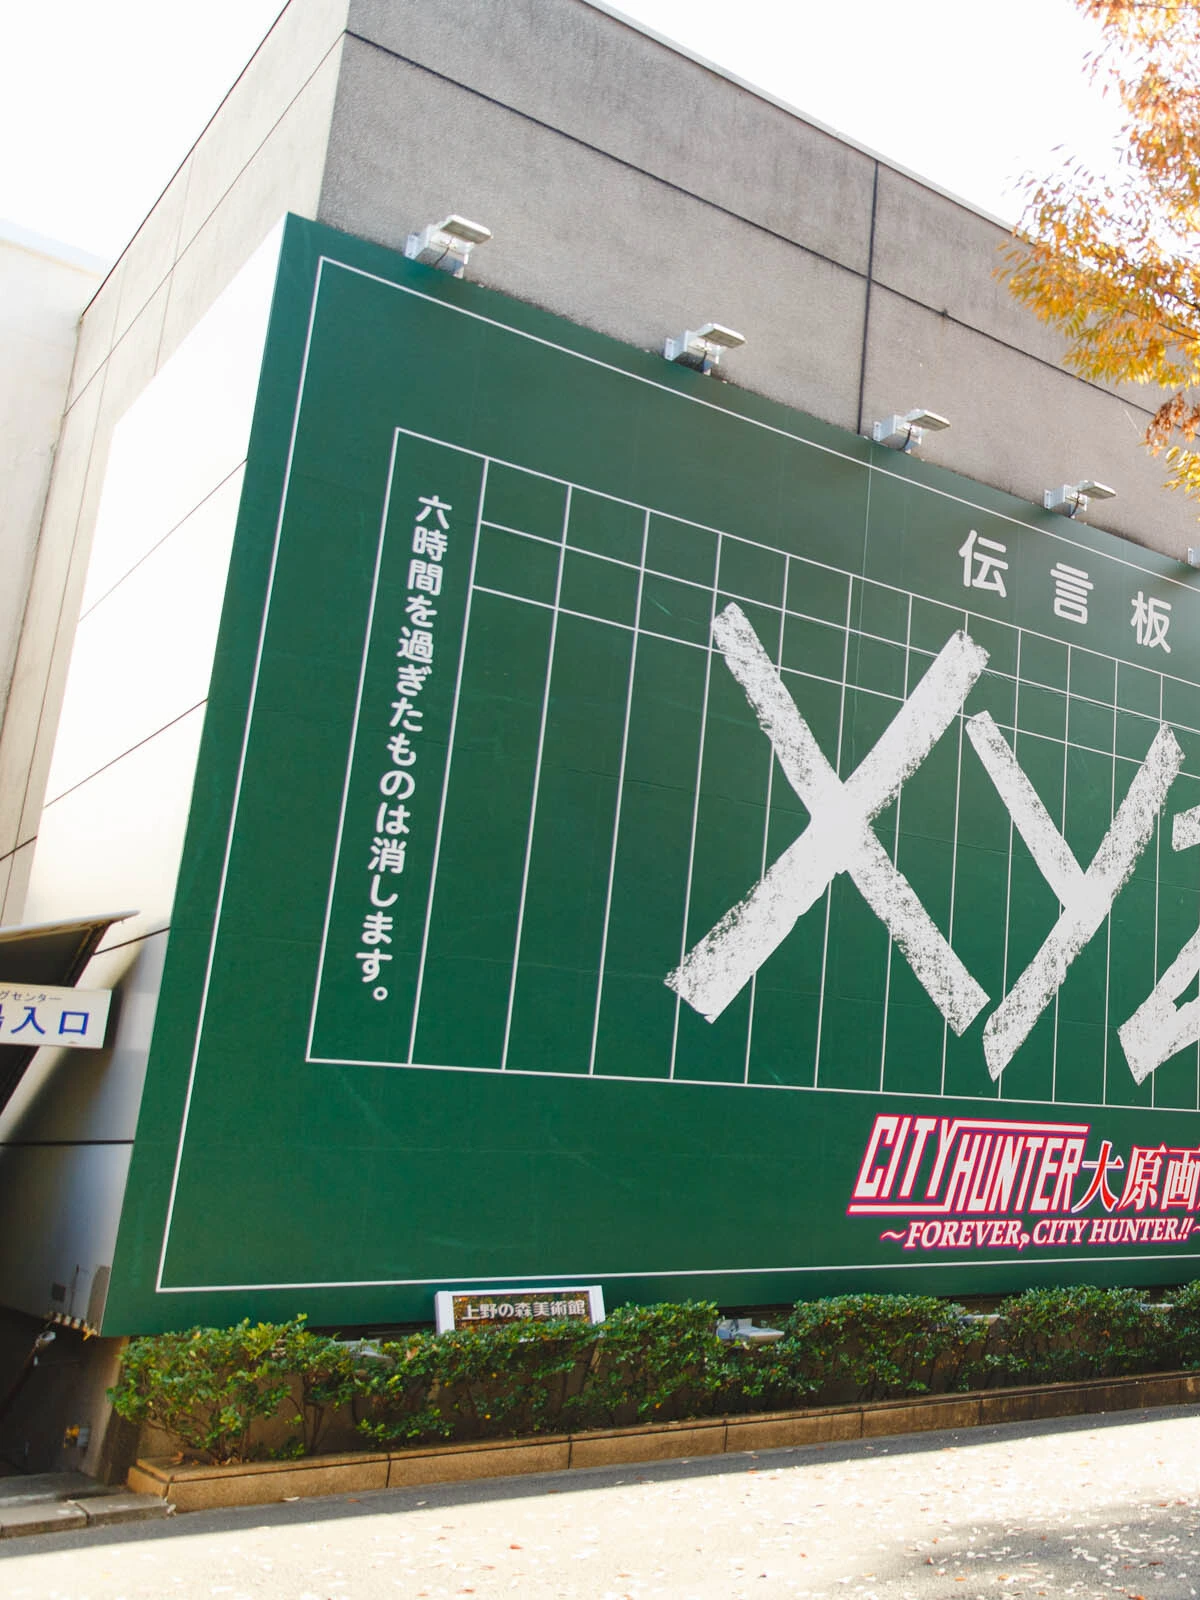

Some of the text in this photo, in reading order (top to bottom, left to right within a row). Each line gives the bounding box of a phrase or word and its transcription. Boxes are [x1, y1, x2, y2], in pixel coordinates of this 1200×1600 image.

[958, 529, 1172, 653] 伝言板
[356, 495, 452, 1000] 六時間を過ぎたものは消します。
[0, 1004, 90, 1035] 入口
[853, 1115, 957, 1198] CITY
[948, 1133, 1087, 1213] HUNTER
[1032, 1218, 1089, 1245] CITY
[461, 1299, 586, 1321] 上野の森美術館
